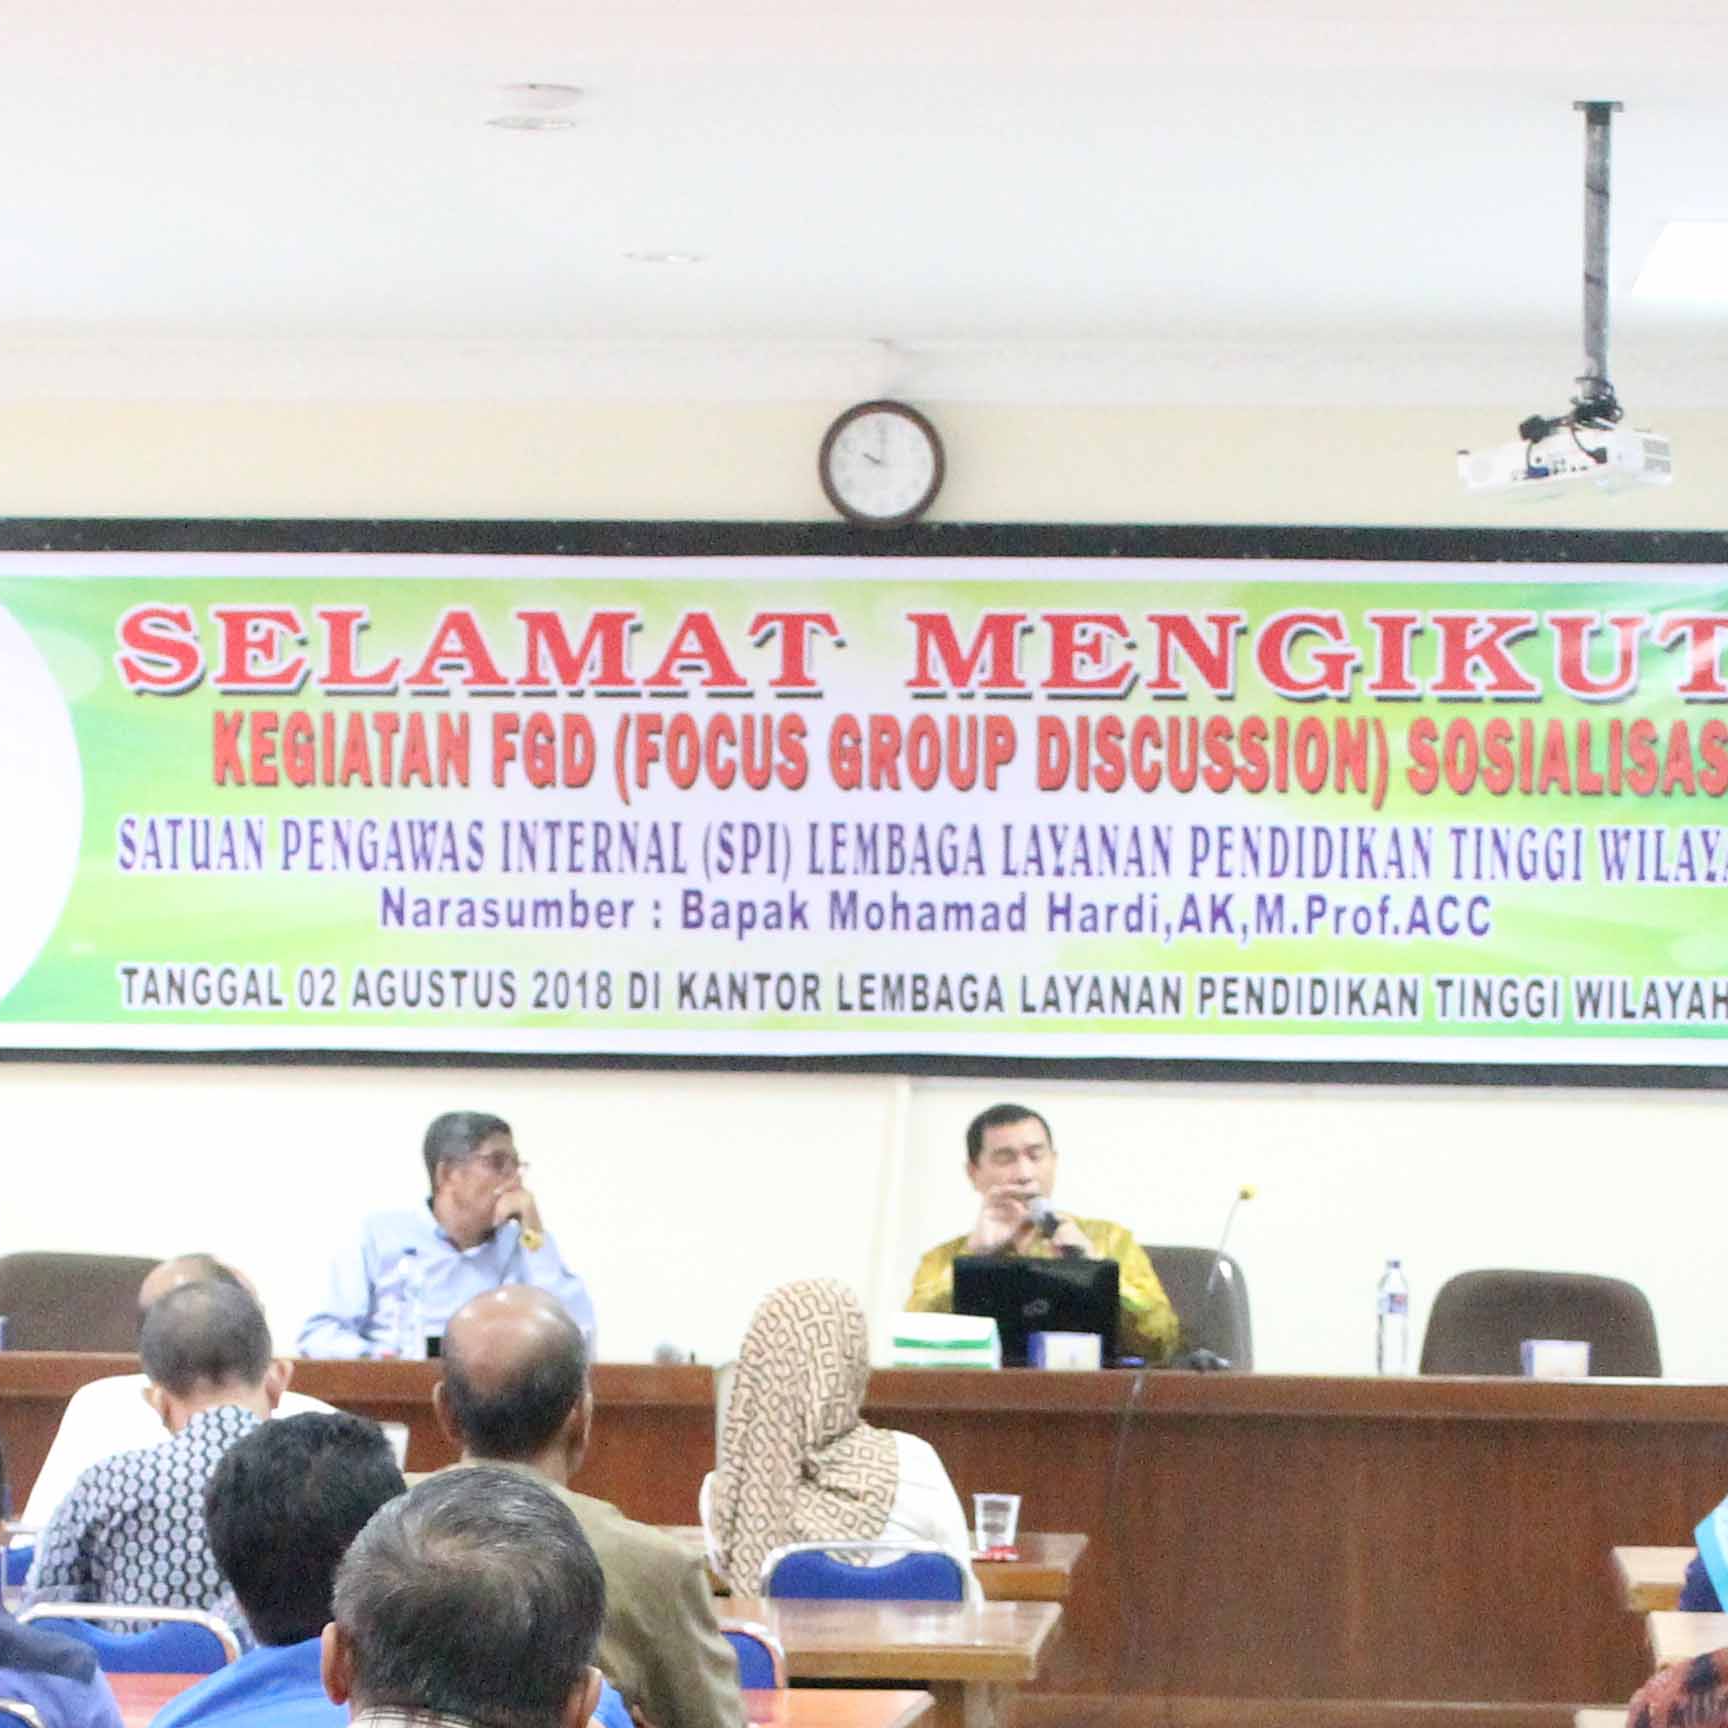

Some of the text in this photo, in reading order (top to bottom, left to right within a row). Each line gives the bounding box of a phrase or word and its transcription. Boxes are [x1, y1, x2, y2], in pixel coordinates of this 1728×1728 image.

[118, 609, 843, 696] SELAMAT
[212, 711, 471, 787] KEGIATAN
[492, 713, 596, 789] FGD
[614, 713, 809, 804] (FOCUS
[828, 713, 1017, 791] GROUP
[1037, 714, 1389, 810] DISCUSSION)
[119, 817, 263, 872] SATUAN
[282, 818, 485, 874] PENGAWAS
[501, 820, 687, 875] INTERNAL
[703, 821, 791, 880] (SPI)
[808, 822, 985, 877] LEMBAGA
[1002, 823, 1172, 878] LAYANAN
[1190, 824, 1432, 881] PENDIDIKAN
[1449, 828, 1582, 881] TINGGI
[381, 887, 633, 929] Narasumber
[682, 888, 809, 940] Bapak
[829, 890, 1027, 932] Mohamad
[1047, 892, 1491, 943] Hardi,AK,M.Prof.ACC
[122, 967, 282, 1009] TANGGAL
[298, 968, 336, 1009] 02
[352, 968, 516, 1009] AGUSTUS
[533, 970, 612, 1011] 2018
[629, 971, 660, 1011] DI
[678, 971, 822, 1012] KANTOR
[837, 973, 1004, 1013] LEMBAGA
[1021, 974, 1183, 1014] LAYANAN
[1198, 975, 1419, 1017] PENDIDIKAN
[1436, 978, 1560, 1017] TINGGI
